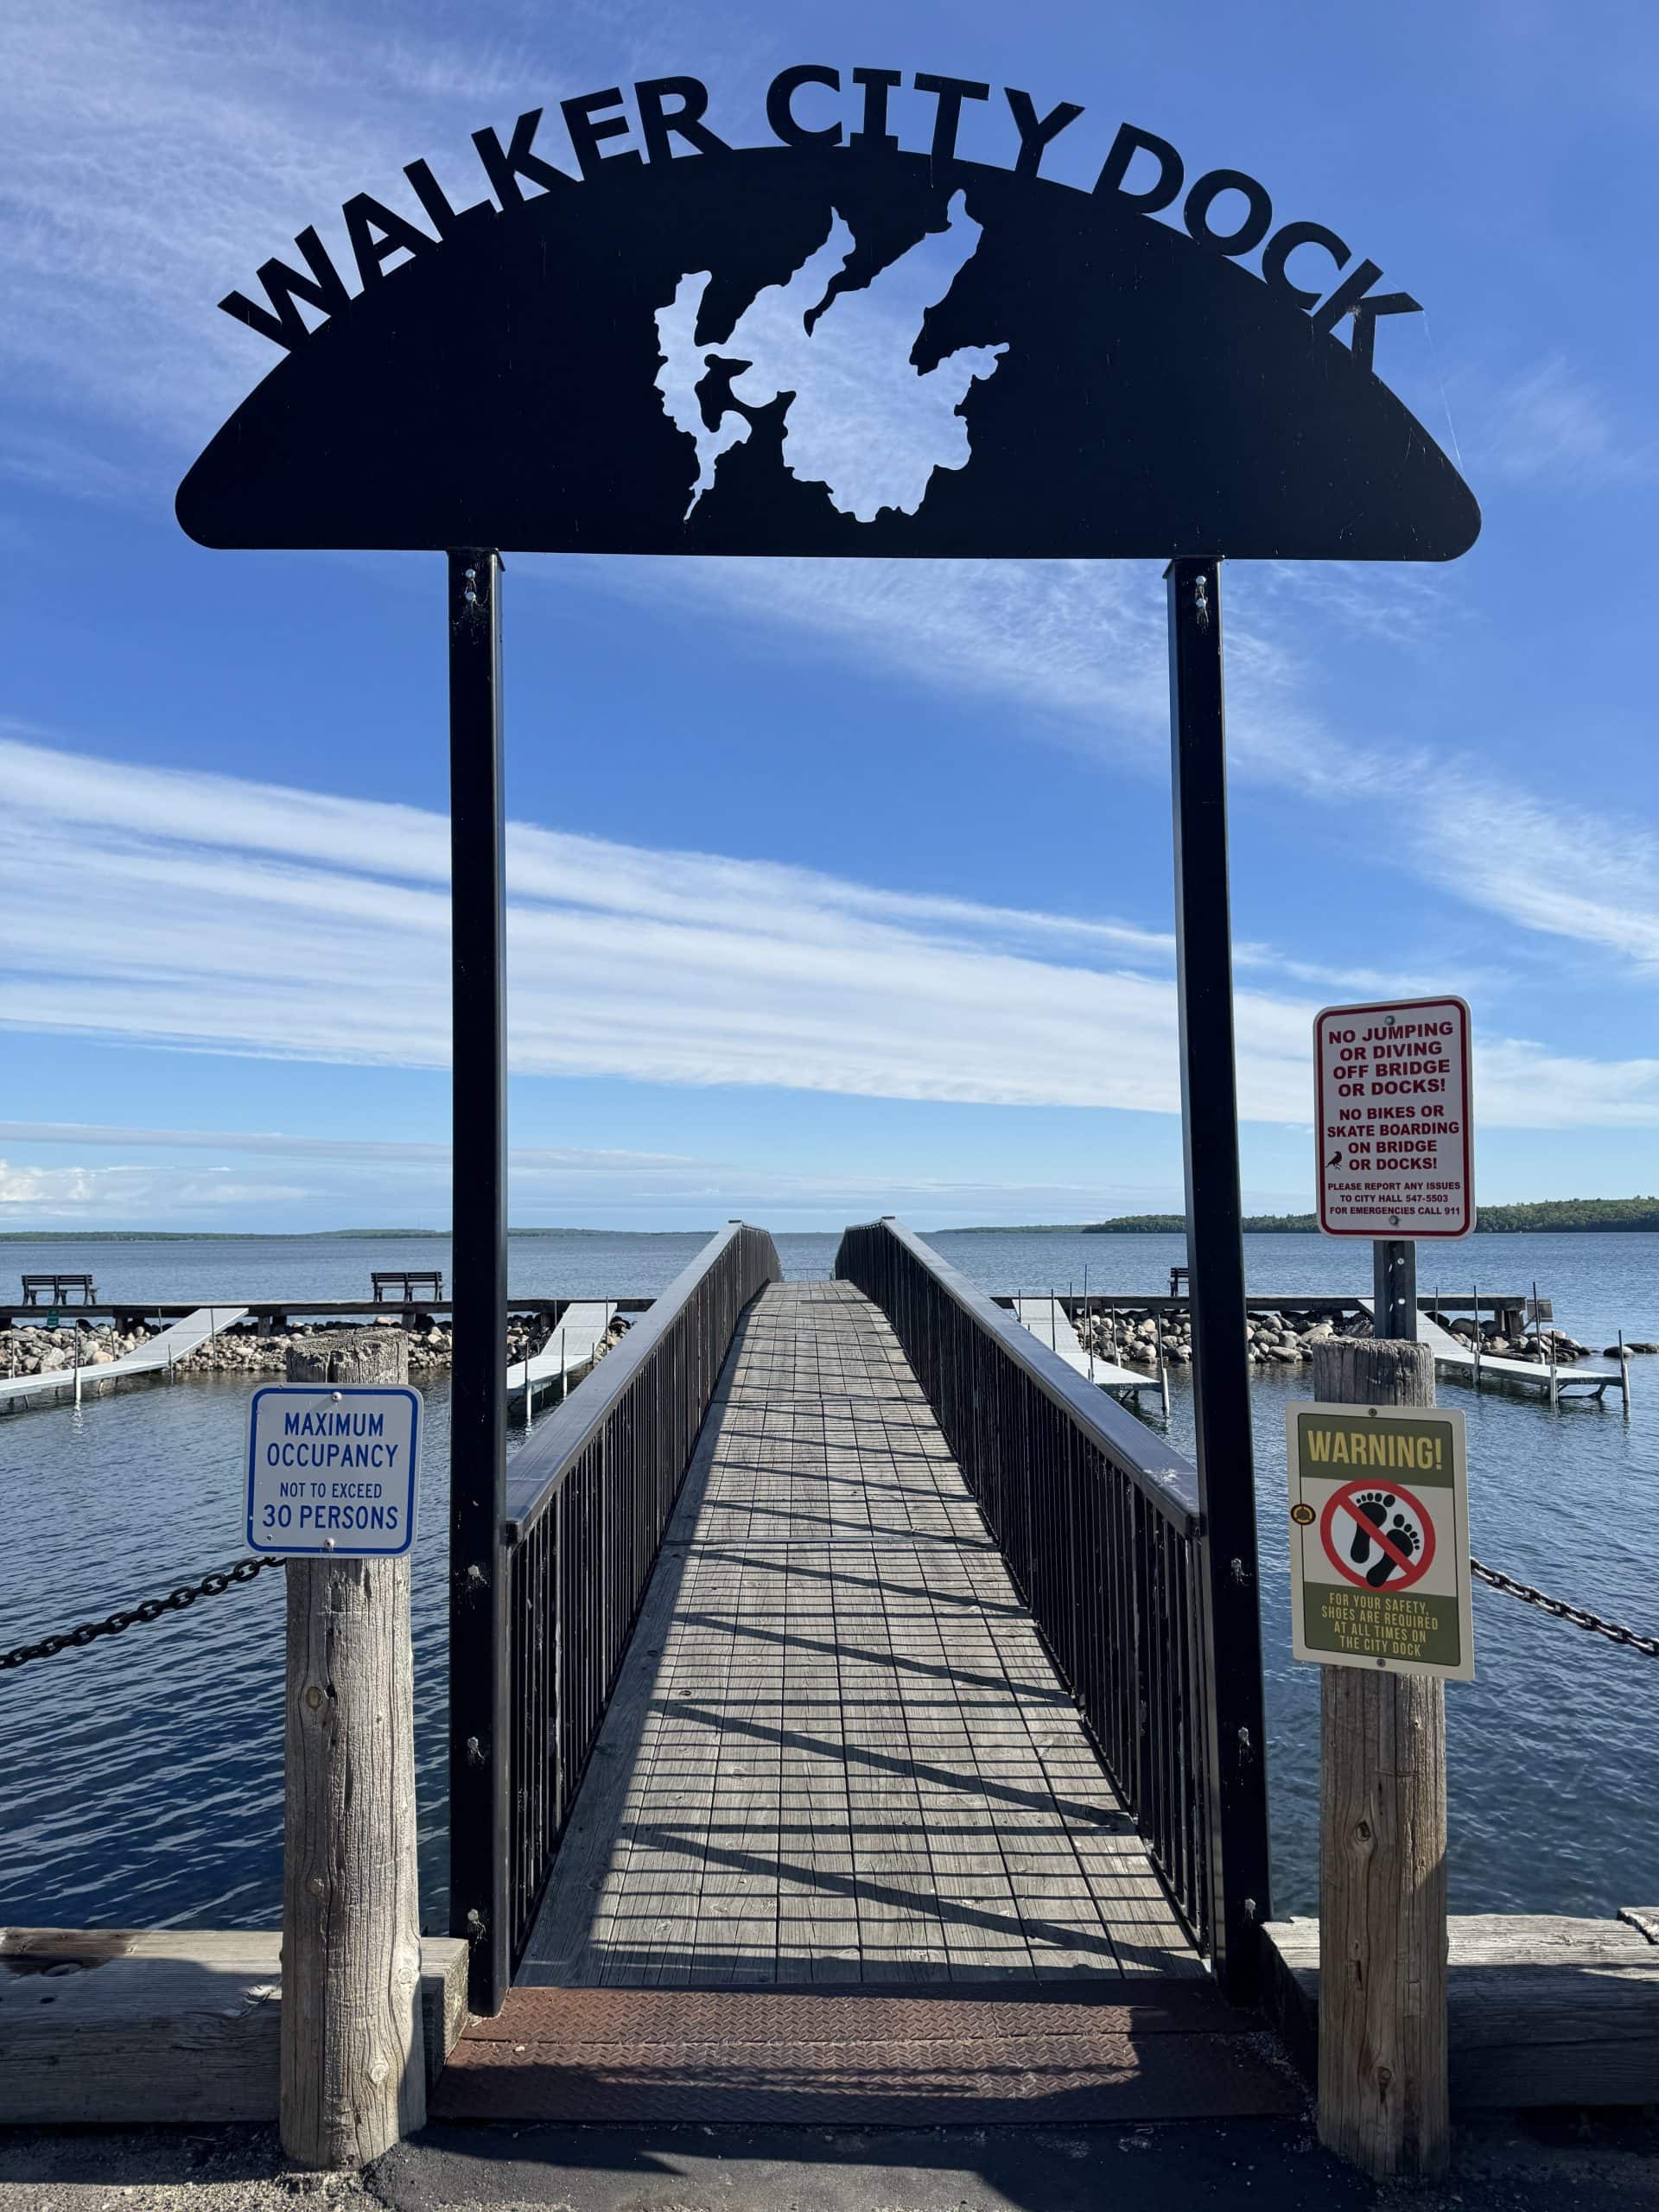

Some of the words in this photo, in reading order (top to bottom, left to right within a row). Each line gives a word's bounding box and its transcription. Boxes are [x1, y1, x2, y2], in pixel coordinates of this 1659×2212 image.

[216, 75, 733, 353] WALKER
[766, 64, 1084, 176] CITY
[1090, 122, 1424, 372] DOCK
[1329, 1030, 1356, 1044] NO
[1363, 1021, 1453, 1042] JUMPING
[1339, 1047, 1367, 1061] OR
[1373, 1041, 1442, 1059] DIVING
[1333, 1065, 1369, 1079] OFF
[1376, 1059, 1450, 1077] BRIDGE
[1338, 1083, 1365, 1096] OR
[1372, 1078, 1446, 1095] DOCKS!
[1339, 1109, 1362, 1121] NO
[1367, 1106, 1415, 1119] BIKES
[1421, 1104, 1444, 1117] OR
[1327, 1125, 1375, 1138] SKATE
[1379, 1122, 1459, 1136] BOARDING
[1348, 1142, 1370, 1154] ON
[1376, 1140, 1437, 1153] BRIDGE
[1349, 1159, 1371, 1171] OR
[1376, 1158, 1437, 1170] DOCKS!
[1426, 1181, 1460, 1190] ISSUES
[1340, 1194, 1352, 1203] TO
[1354, 1194, 1376, 1203] CITY
[1330, 1206, 1348, 1215] FOR
[1350, 1206, 1415, 1215] EMERGENCIES
[1418, 1206, 1442, 1215] CALL
[1444, 1206, 1460, 1215] 911
[284, 1412, 384, 1437] MAXIMUM
[267, 1443, 398, 1467] OCCUPANCY
[1307, 1430, 1442, 1470] WARNING!
[279, 1483, 306, 1497] NOT
[310, 1483, 326, 1497] TO
[332, 1484, 382, 1498] EXCEED
[263, 1504, 291, 1528] 30
[300, 1505, 398, 1529] PERSONS
[1329, 1592, 1349, 1605] FOR
[1352, 1594, 1381, 1610] YOUR
[1321, 1605, 1356, 1621] SHOES
[1359, 1611, 1380, 1624] ARE
[1385, 1612, 1439, 1630] REQUIRED
[1334, 1621, 1348, 1633] AT
[1351, 1623, 1371, 1637] ALL
[1374, 1625, 1408, 1641] TIMES
[1412, 1630, 1427, 1643] ON
[1339, 1635, 1360, 1649] THE
[1363, 1637, 1389, 1652] CITY
[1393, 1641, 1421, 1656] DOCK
